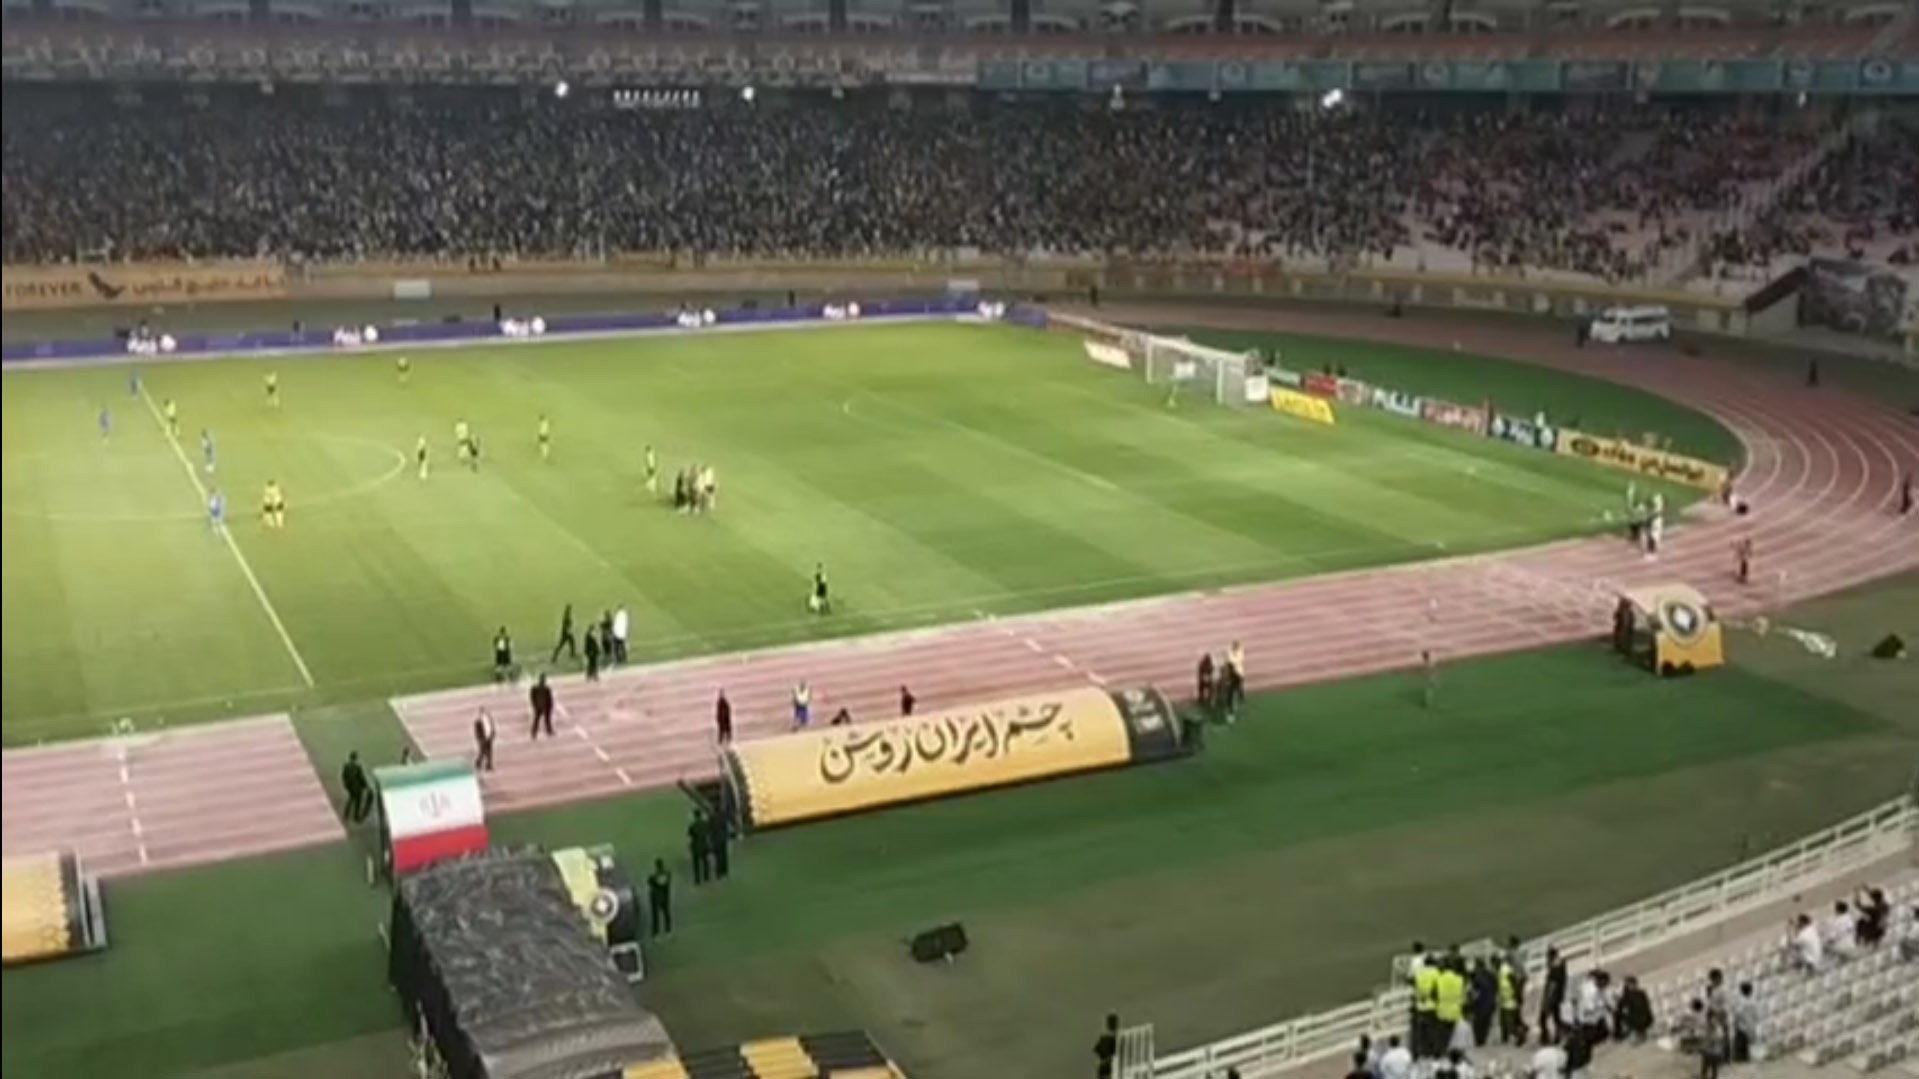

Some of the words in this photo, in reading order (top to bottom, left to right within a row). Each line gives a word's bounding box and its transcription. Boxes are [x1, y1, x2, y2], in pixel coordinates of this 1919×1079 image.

[915, 713, 998, 764] ایران
[1003, 701, 1074, 754] چشم
[819, 730, 914, 783] روشن
